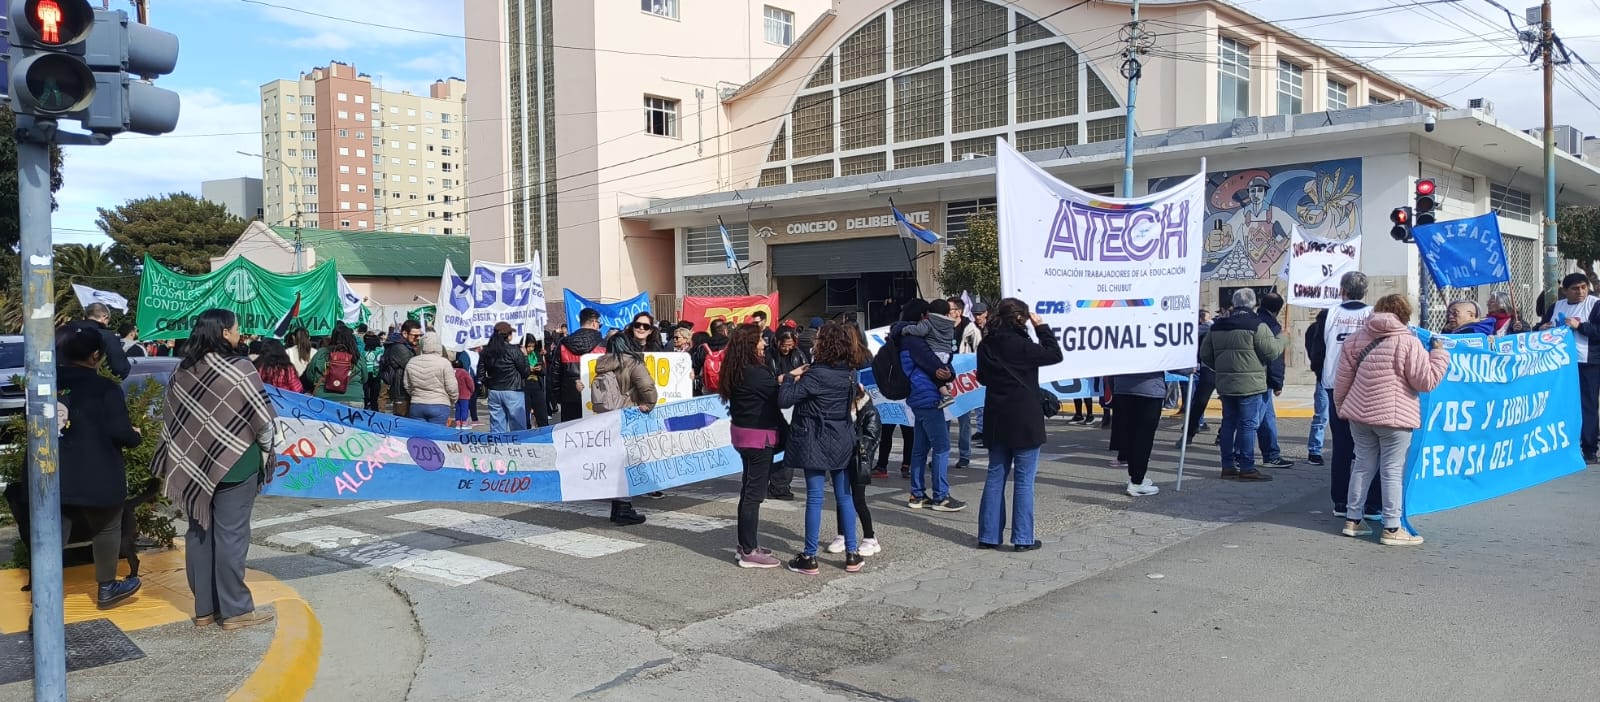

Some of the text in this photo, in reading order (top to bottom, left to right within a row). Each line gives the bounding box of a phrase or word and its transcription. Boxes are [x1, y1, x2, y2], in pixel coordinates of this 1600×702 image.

[786, 210, 930, 235] CONCEJO DELIBERNTE
[1044, 199, 1190, 262] ATECH
[1044, 265, 1186, 278] ASOCIACIÓN TRABAJADORES DE LA EDUCACIÓN
[1321, 264, 1333, 277] DE
[152, 284, 201, 301] ROSALES
[1096, 283, 1132, 292] DEL CHUBUT
[1051, 322, 1194, 351] EGIONAL SUR
[336, 408, 376, 427] HAY
[1481, 400, 1495, 430] Y
[564, 430, 612, 449] ATECH
[625, 428, 718, 465] EDUCACION
[413, 445, 440, 462] 204
[446, 443, 463, 455] NO
[468, 444, 503, 457] ENTRA
[527, 448, 541, 459] EL
[1490, 438, 1514, 470] DEL
[582, 462, 608, 481] SUR
[628, 447, 730, 487] ES NUESTRA
[458, 479, 475, 490] DE
